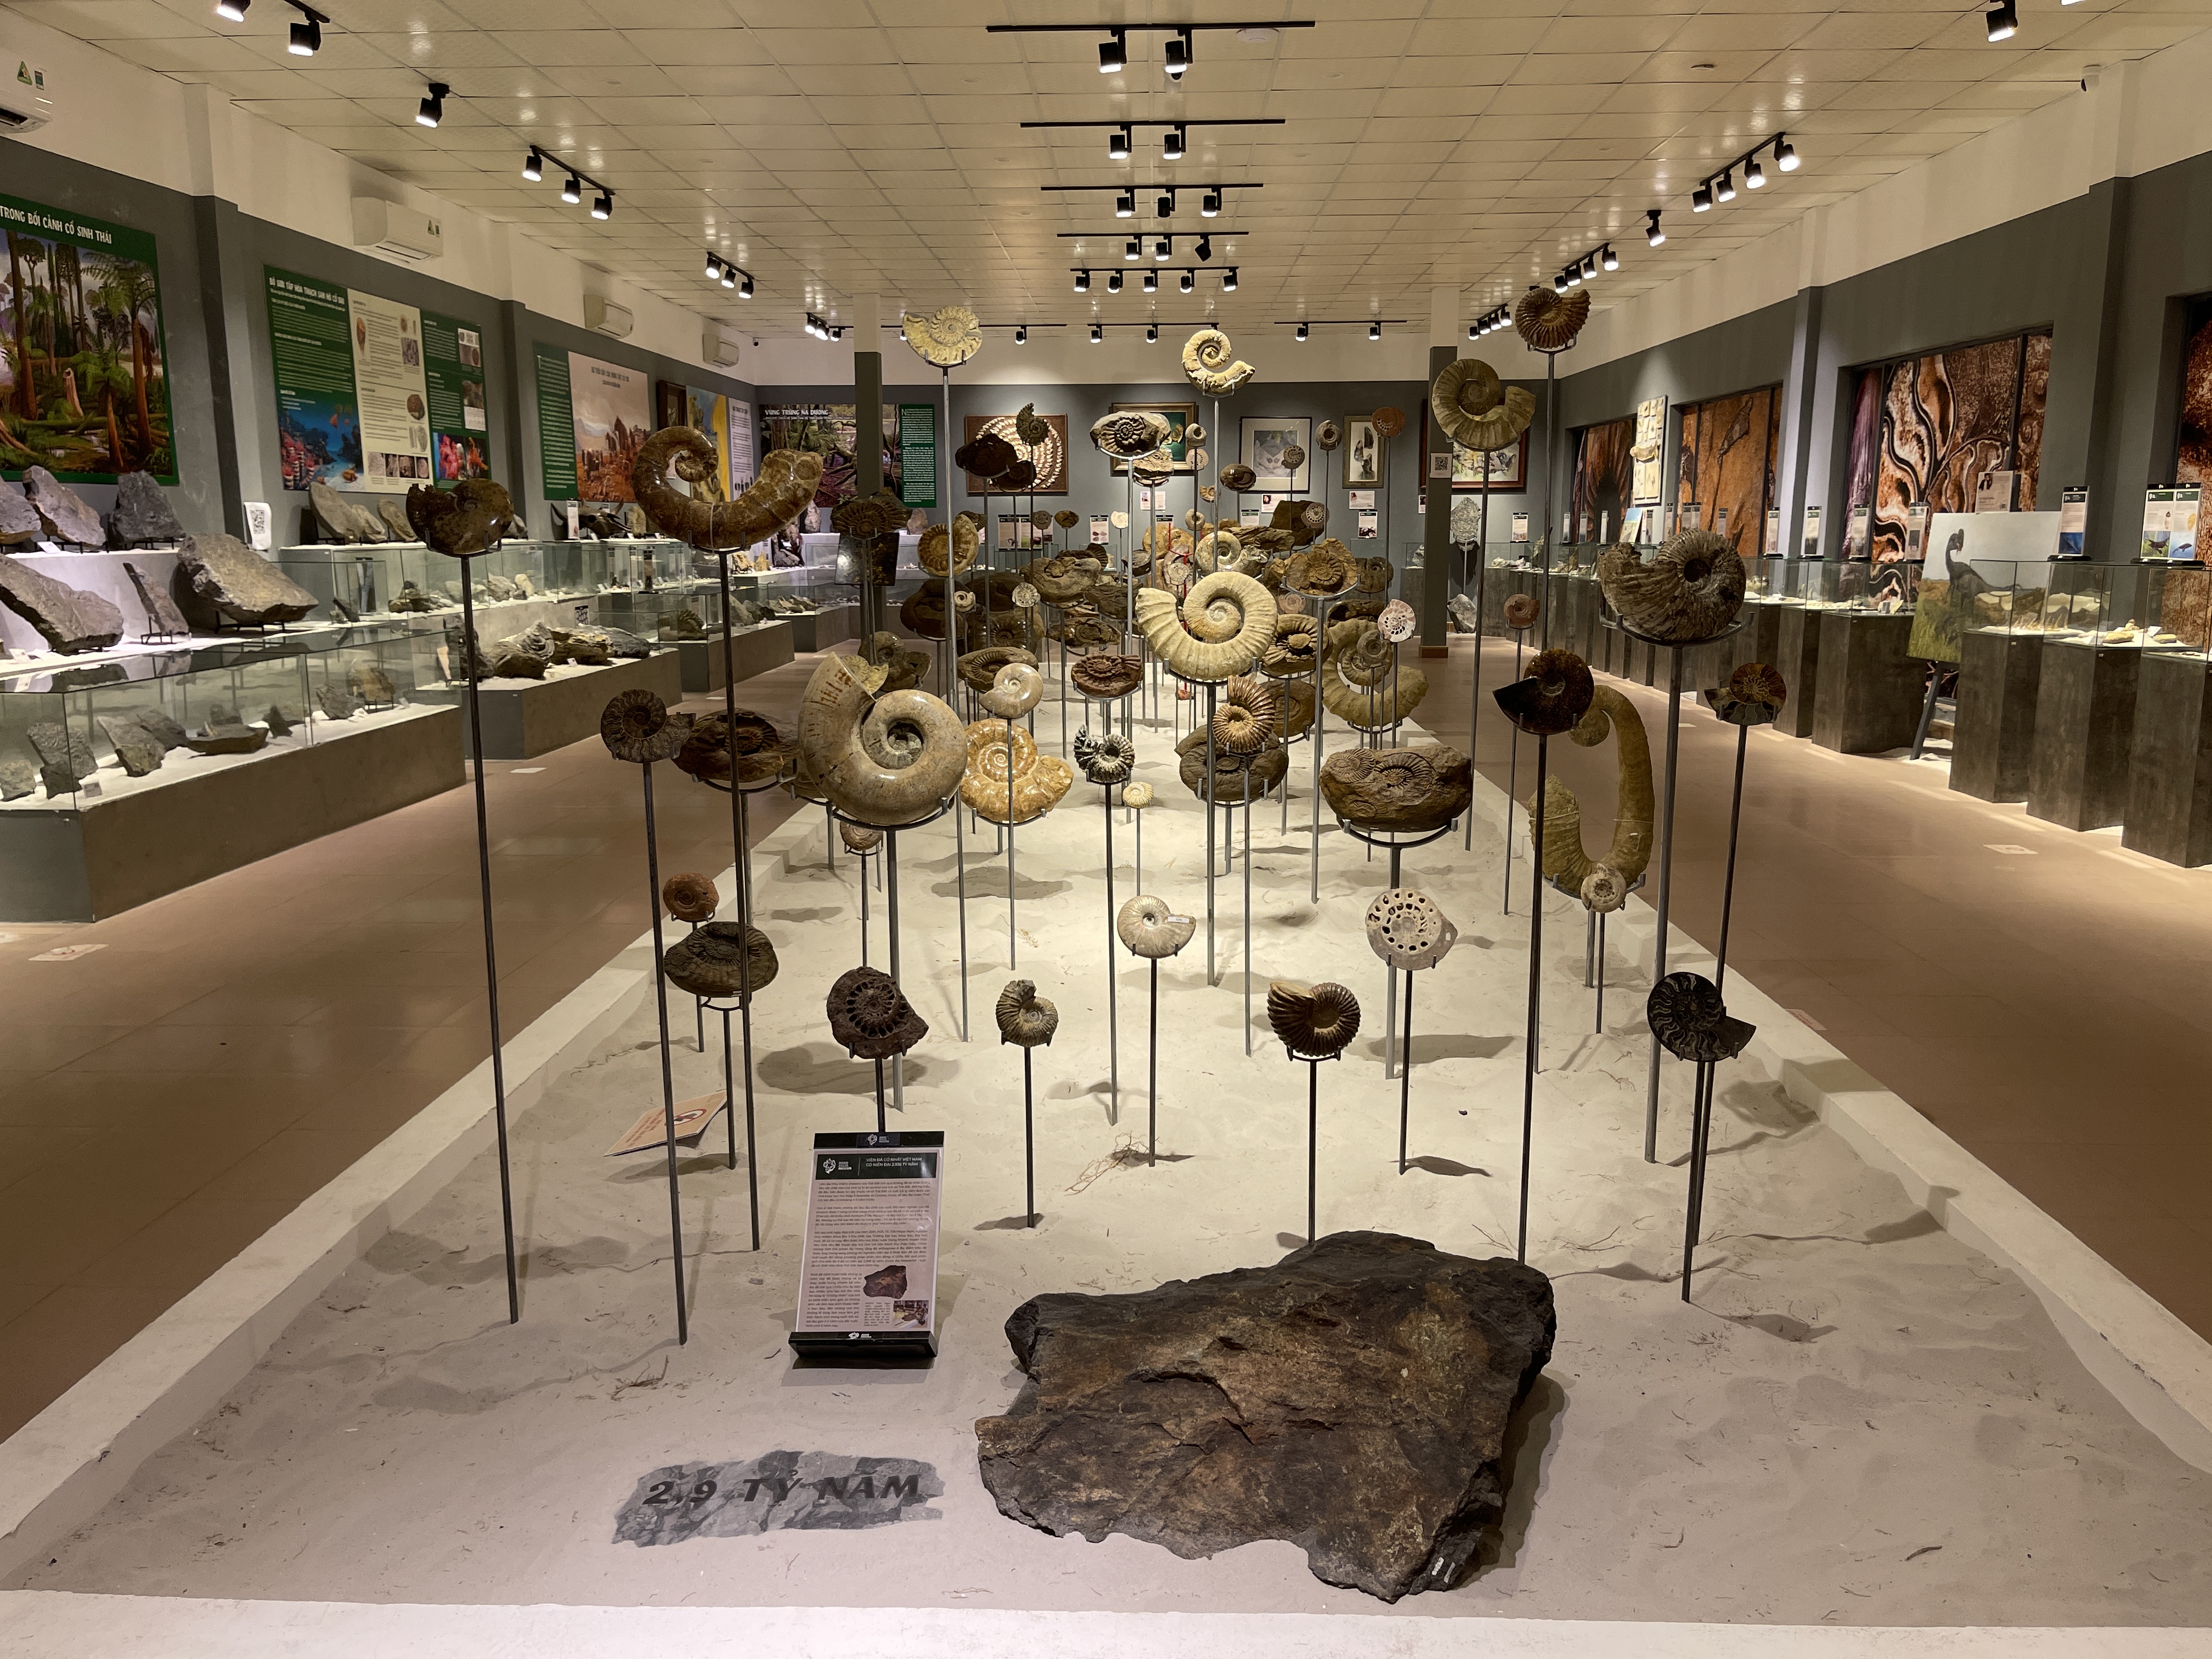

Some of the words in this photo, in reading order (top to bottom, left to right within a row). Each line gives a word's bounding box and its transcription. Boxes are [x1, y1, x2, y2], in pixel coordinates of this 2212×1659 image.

[0, 205, 26, 222] TRONG
[27, 210, 41, 227] BỐI
[43, 214, 63, 232] CẢNH
[65, 219, 75, 235] CỔ
[77, 225, 94, 240] SINH
[94, 230, 112, 244] THÁI
